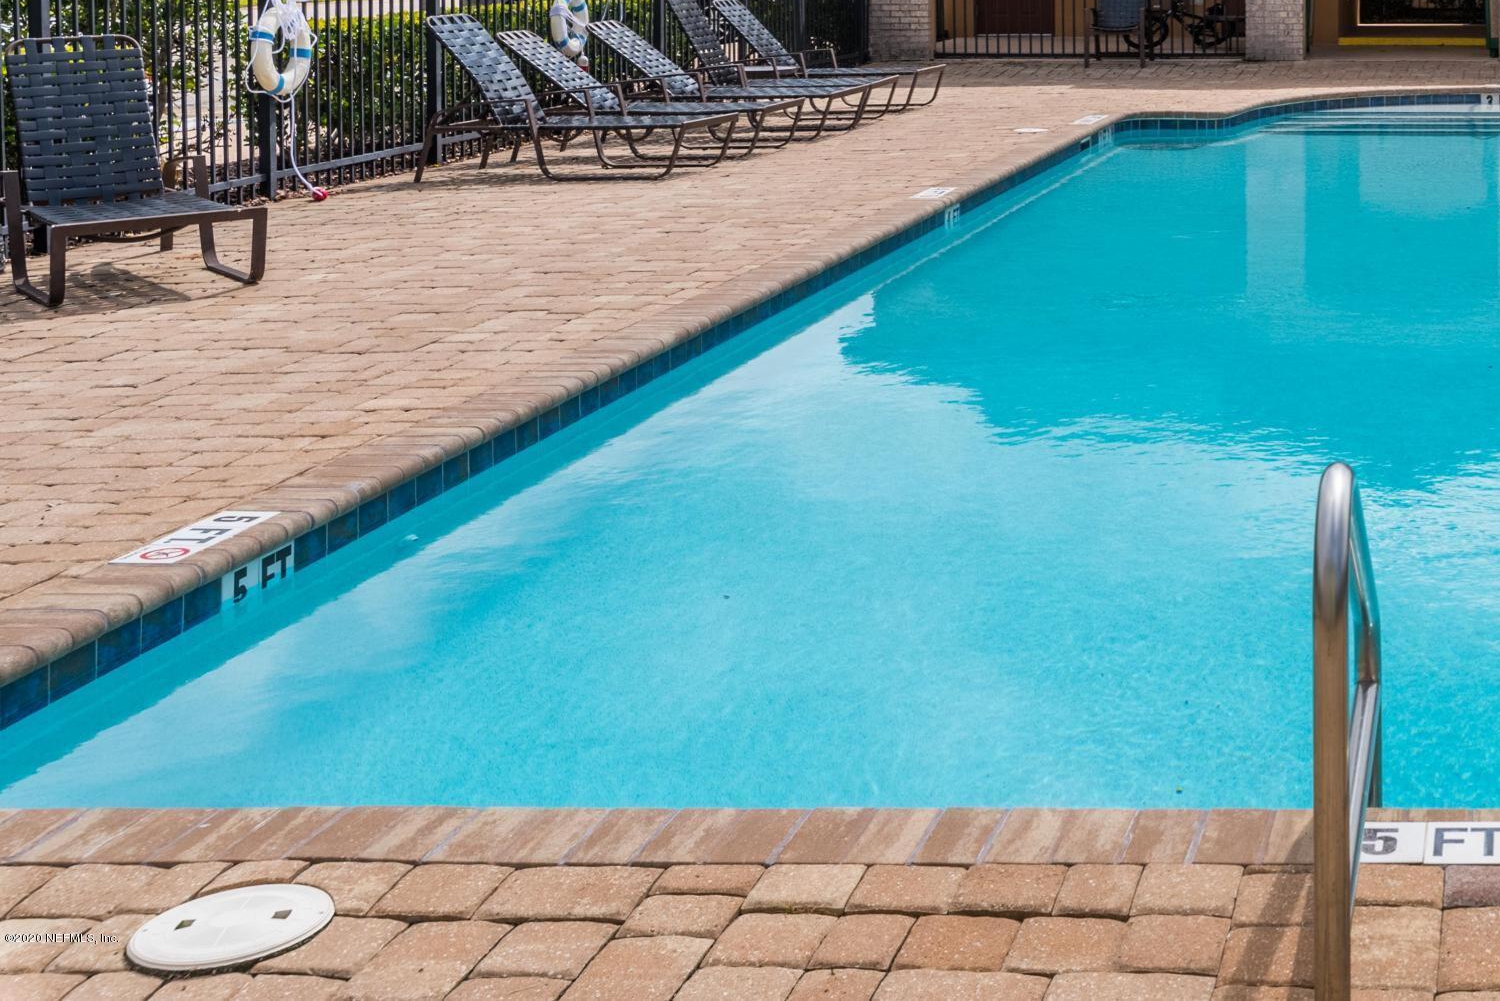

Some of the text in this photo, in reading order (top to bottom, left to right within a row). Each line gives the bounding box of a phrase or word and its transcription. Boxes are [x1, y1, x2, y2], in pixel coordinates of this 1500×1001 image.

[233, 544, 292, 603] 5 FT
[1362, 827, 1399, 856] 5
